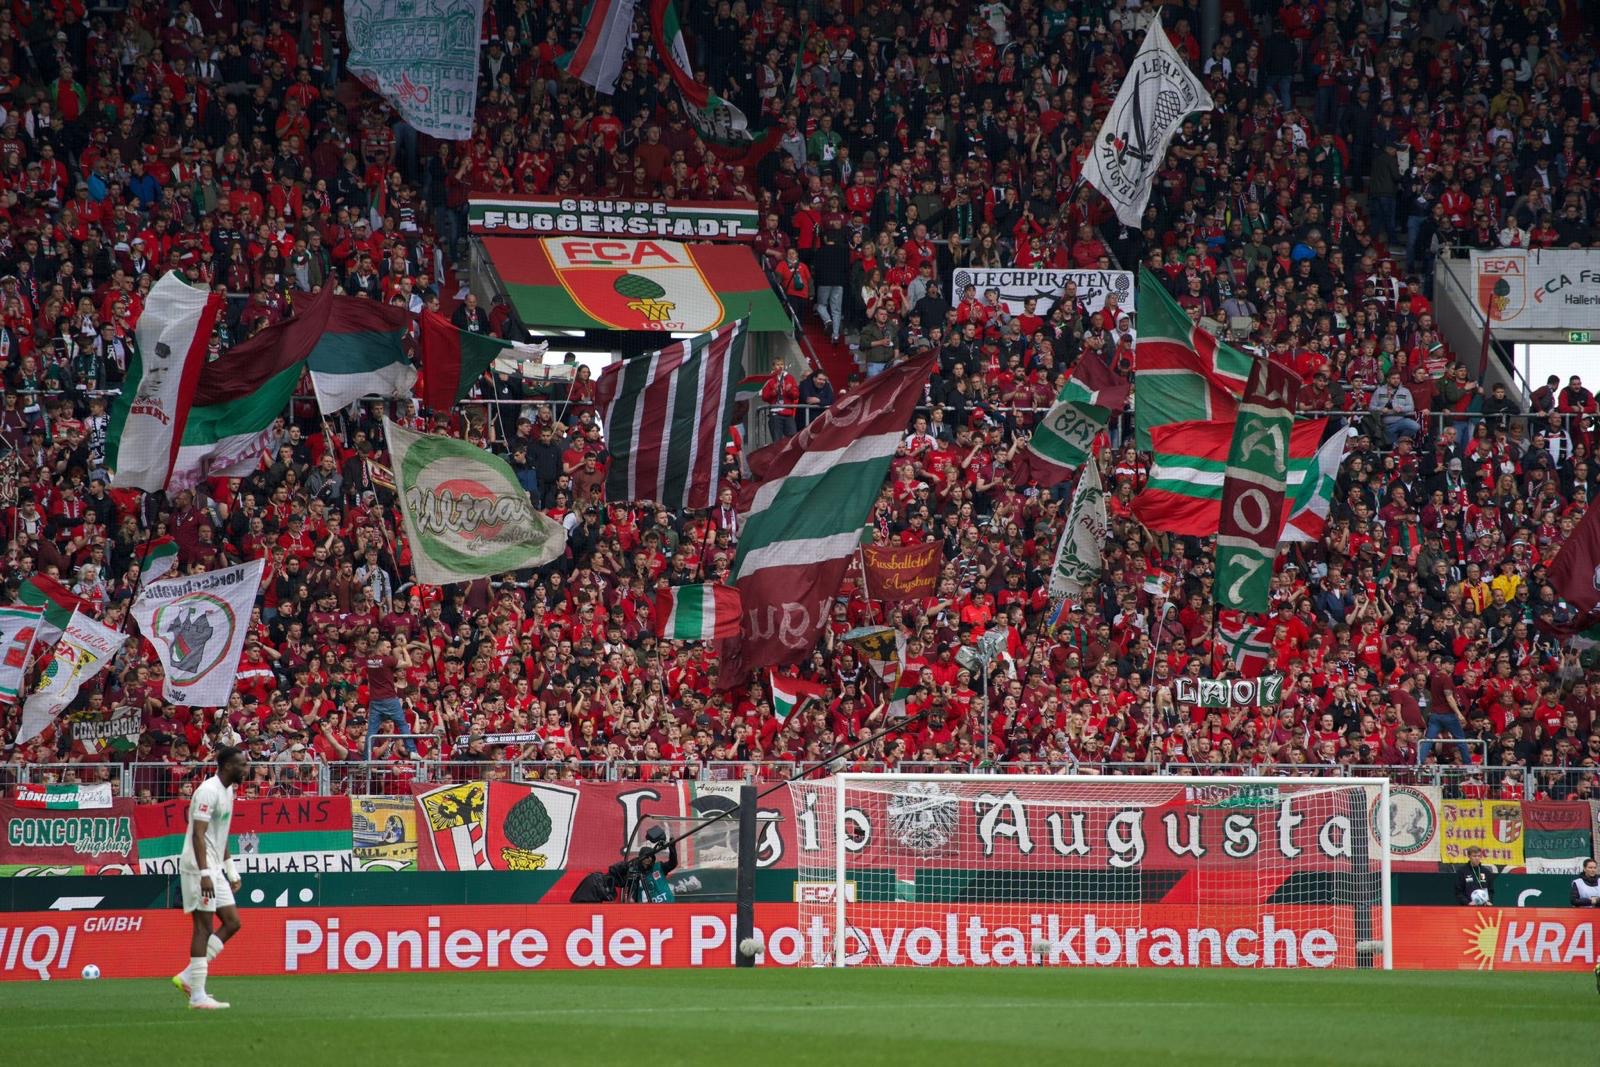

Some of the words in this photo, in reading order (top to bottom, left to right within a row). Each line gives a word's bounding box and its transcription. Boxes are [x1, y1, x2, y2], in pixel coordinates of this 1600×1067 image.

[560, 198, 668, 215] GRUPPE
[483, 210, 743, 238] FUGGERSTADT
[561, 241, 679, 265] FCA
[1483, 260, 1520, 273] FCA
[971, 271, 1113, 291] LECHPIRATEN
[1534, 274, 1572, 303] FCA
[641, 320, 685, 331] 1907
[72, 717, 141, 741] CONCORDIA
[259, 800, 330, 826] FANS
[1443, 804, 1484, 822] Frei
[8, 816, 133, 847] CONCORDIA
[974, 789, 1352, 868] Augusta
[1445, 826, 1486, 840] statt
[74, 838, 133, 857] Augsburg
[1446, 844, 1513, 860] Baern
[651, 892, 668, 904] OST
[83, 916, 143, 932] GMBH
[284, 914, 551, 971] Pioniere
[565, 914, 673, 967] der
[690, 912, 1339, 970] Photovoltaikbranche
[1503, 920, 1600, 964] KRA
